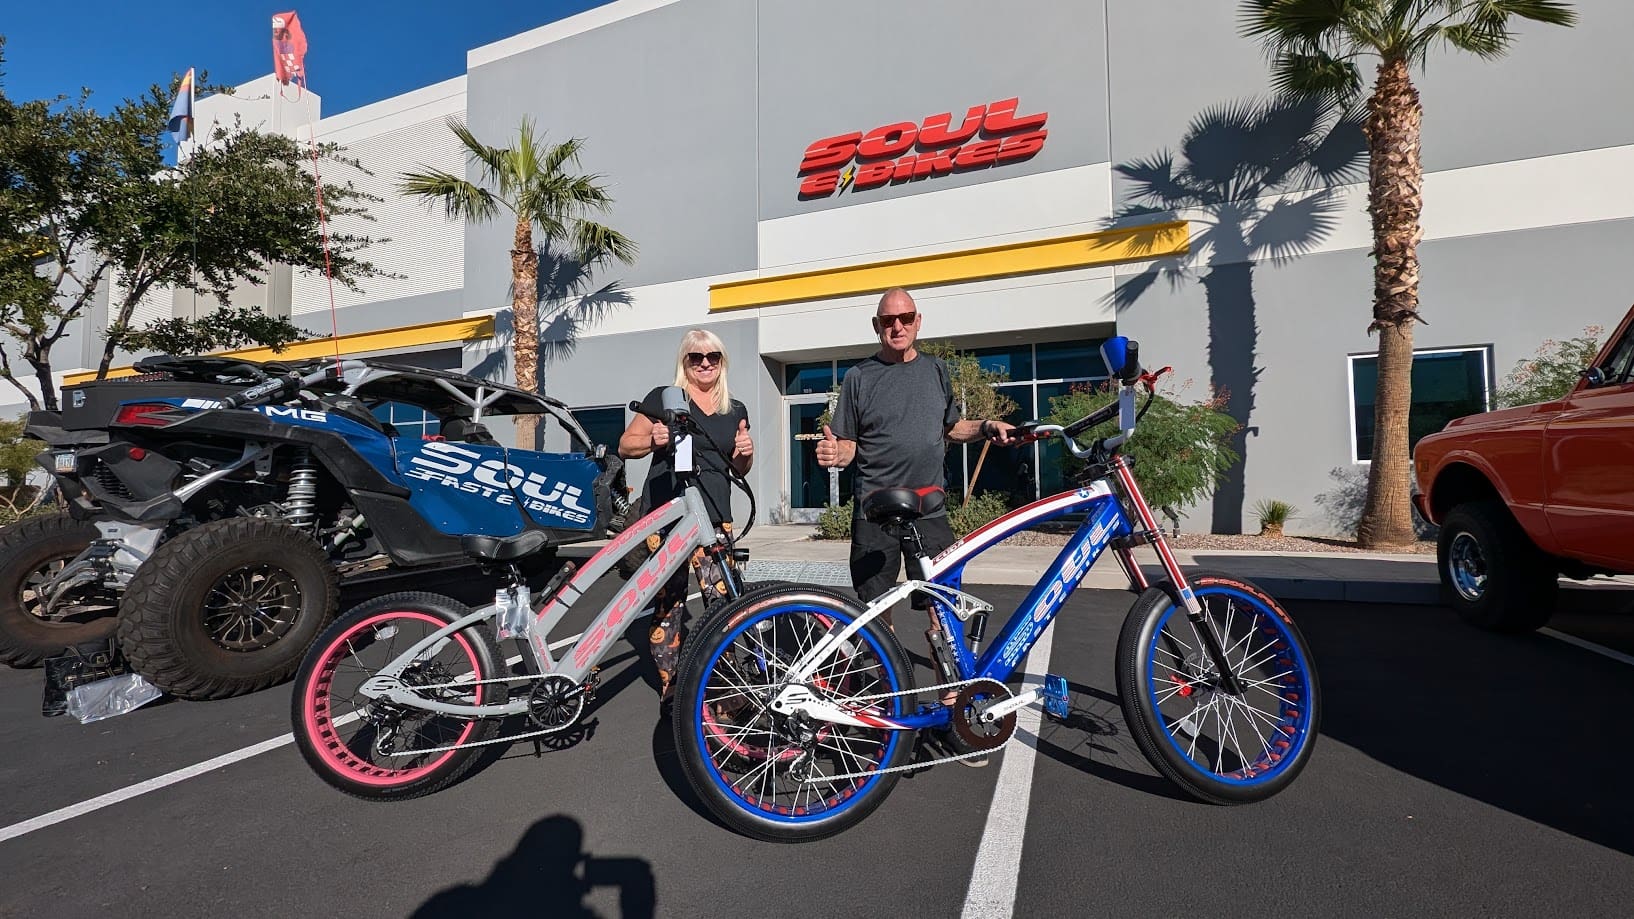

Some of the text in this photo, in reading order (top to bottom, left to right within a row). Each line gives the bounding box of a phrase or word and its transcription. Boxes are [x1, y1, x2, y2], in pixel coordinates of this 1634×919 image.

[798, 129, 1048, 199] E BIKES
[799, 96, 1048, 175] SOUL
[253, 405, 327, 423] MG
[404, 467, 499, 498] FAST
[529, 500, 588, 524] BIKES
[411, 442, 591, 515] SOUL
[573, 525, 699, 669] SOUL
[1003, 512, 1119, 667] SOUL
